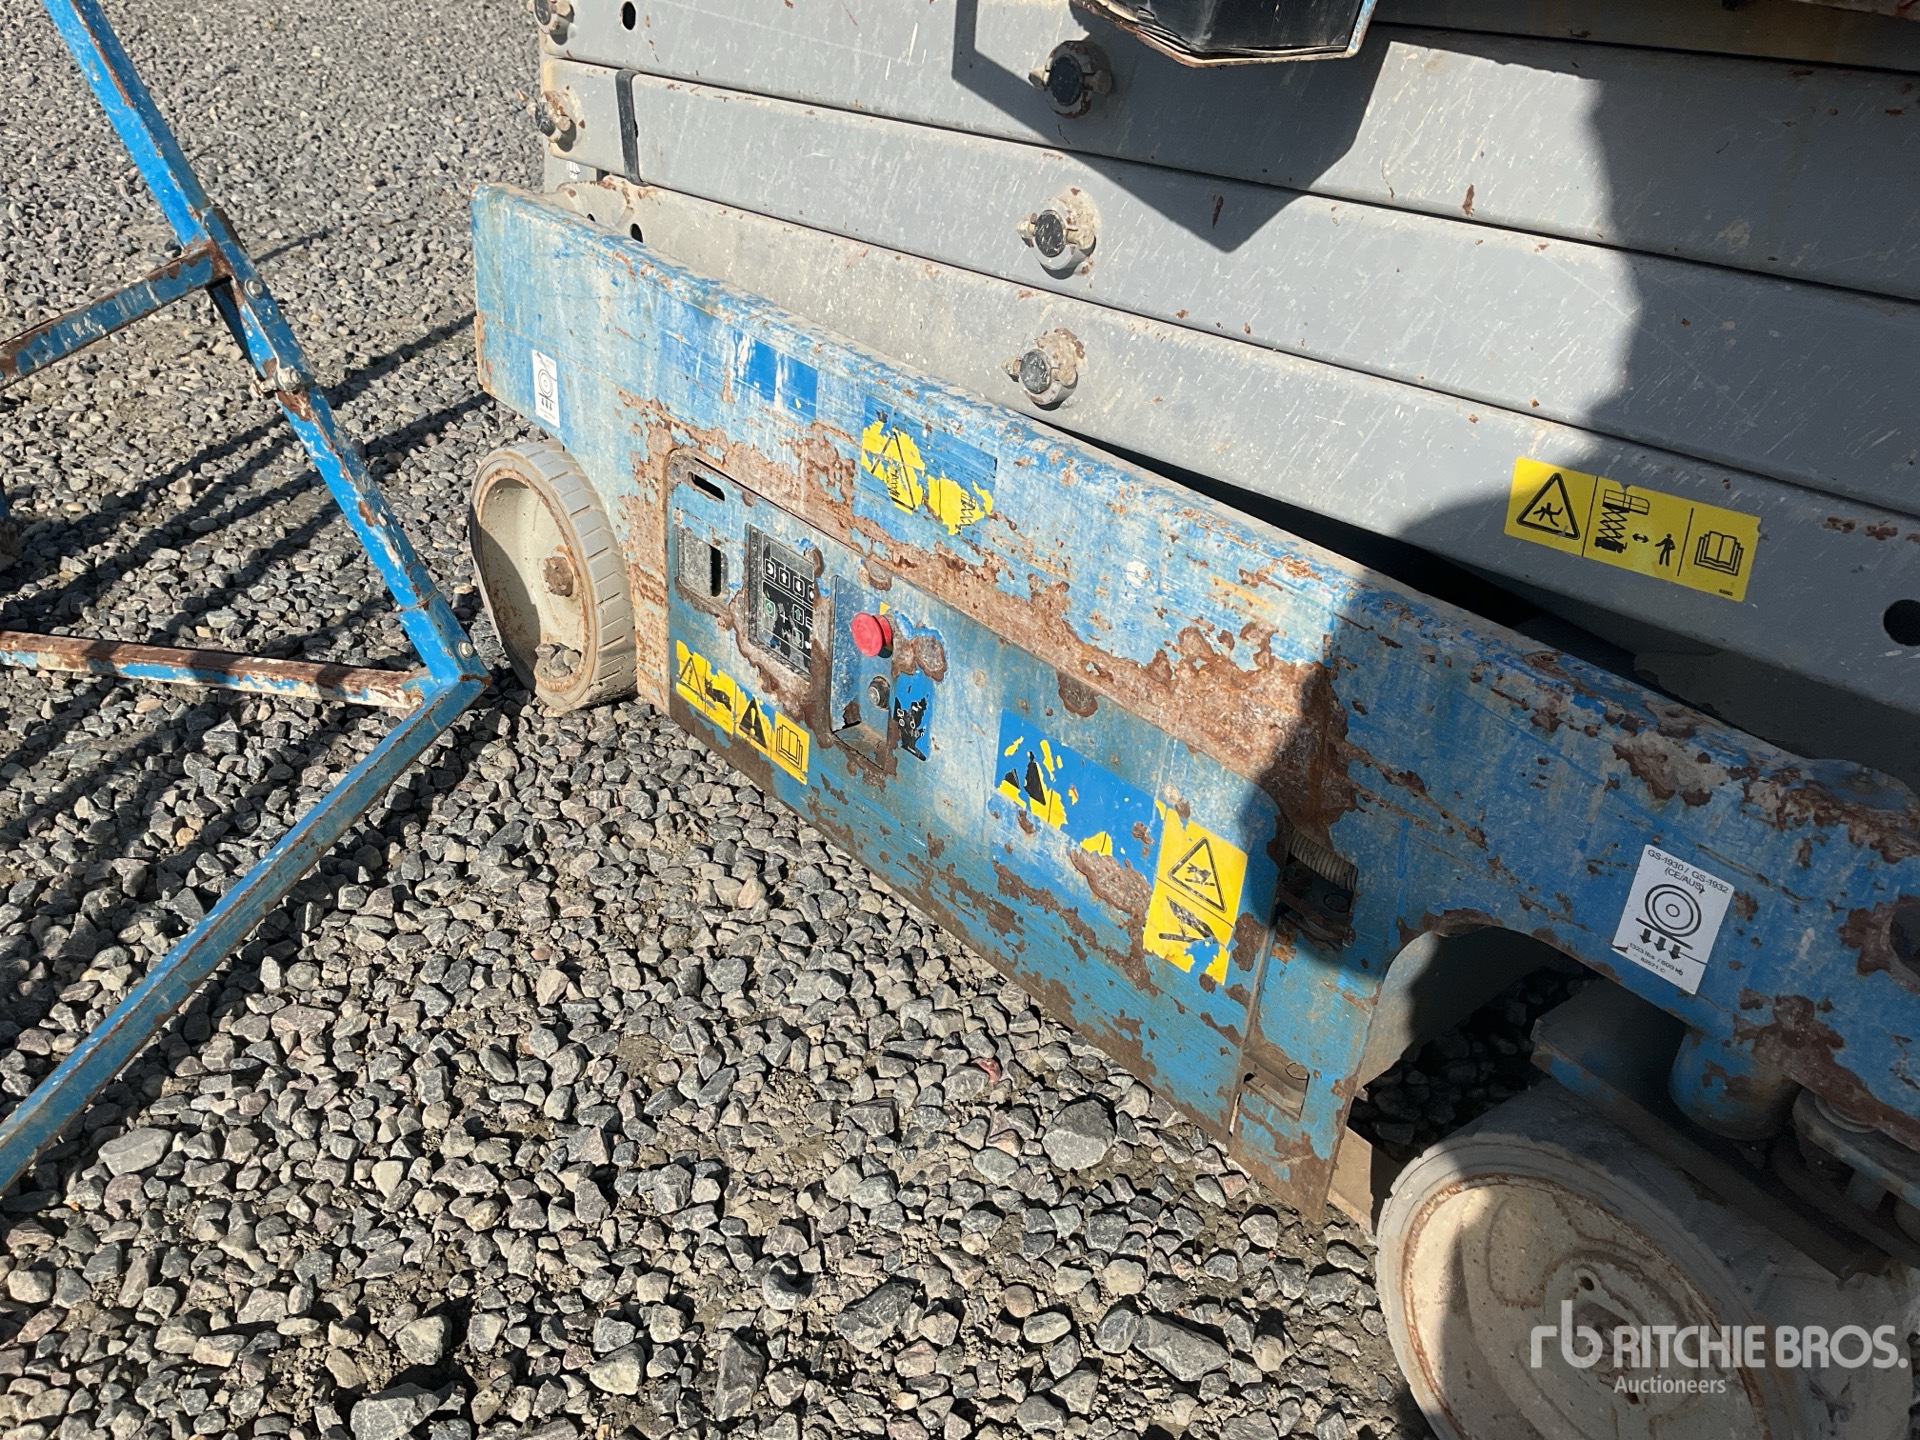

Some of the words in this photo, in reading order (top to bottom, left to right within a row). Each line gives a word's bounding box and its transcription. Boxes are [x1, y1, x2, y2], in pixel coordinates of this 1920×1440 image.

[1648, 849, 1684, 871] GS-1930
[1691, 870, 1729, 893] GS-1932
[1664, 867, 1705, 893] (CE/AUS)
